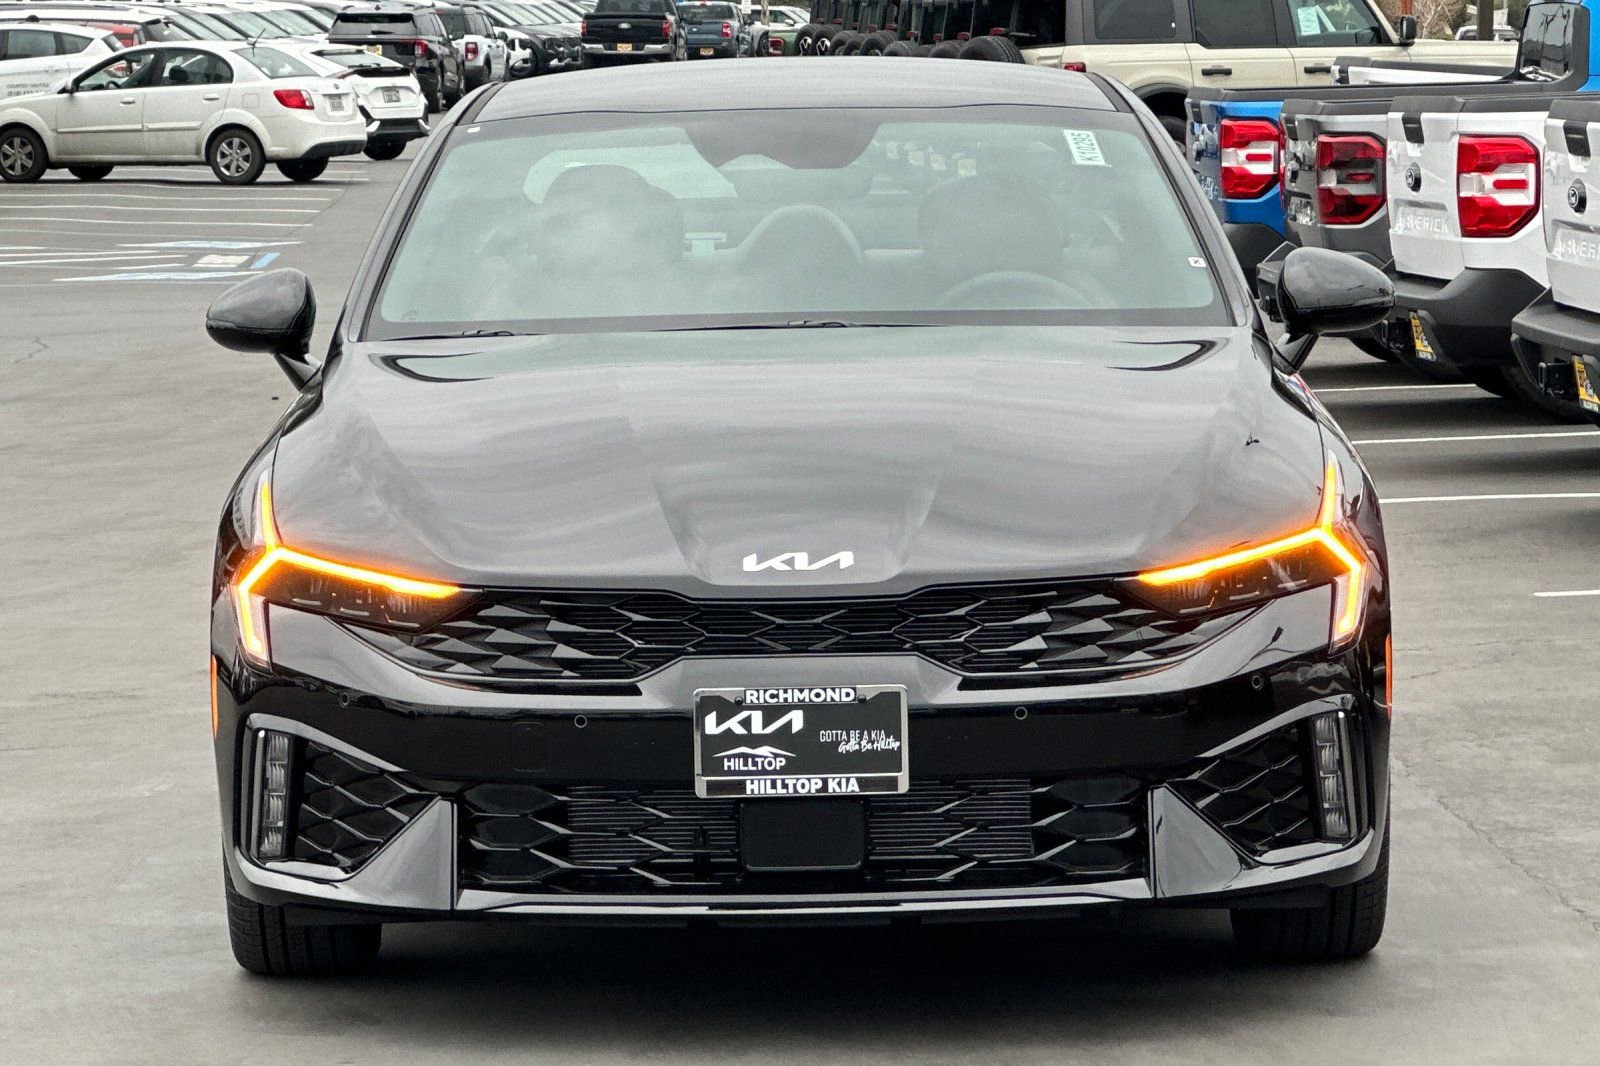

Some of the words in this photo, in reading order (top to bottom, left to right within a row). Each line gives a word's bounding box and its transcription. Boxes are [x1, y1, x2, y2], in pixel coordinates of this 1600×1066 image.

[743, 551, 855, 571] KIA
[745, 688, 855, 704] RICHMOND
[704, 710, 804, 735] KIA
[819, 730, 848, 742] GOTTA
[849, 729, 861, 742] BE
[862, 729, 869, 741] A
[871, 729, 886, 741] KIA
[838, 739, 860, 754] Gotta
[860, 739, 873, 753] Be
[723, 757, 786, 771] HILLTOP
[745, 779, 823, 795] HILLTOP
[827, 778, 860, 793] KIA
